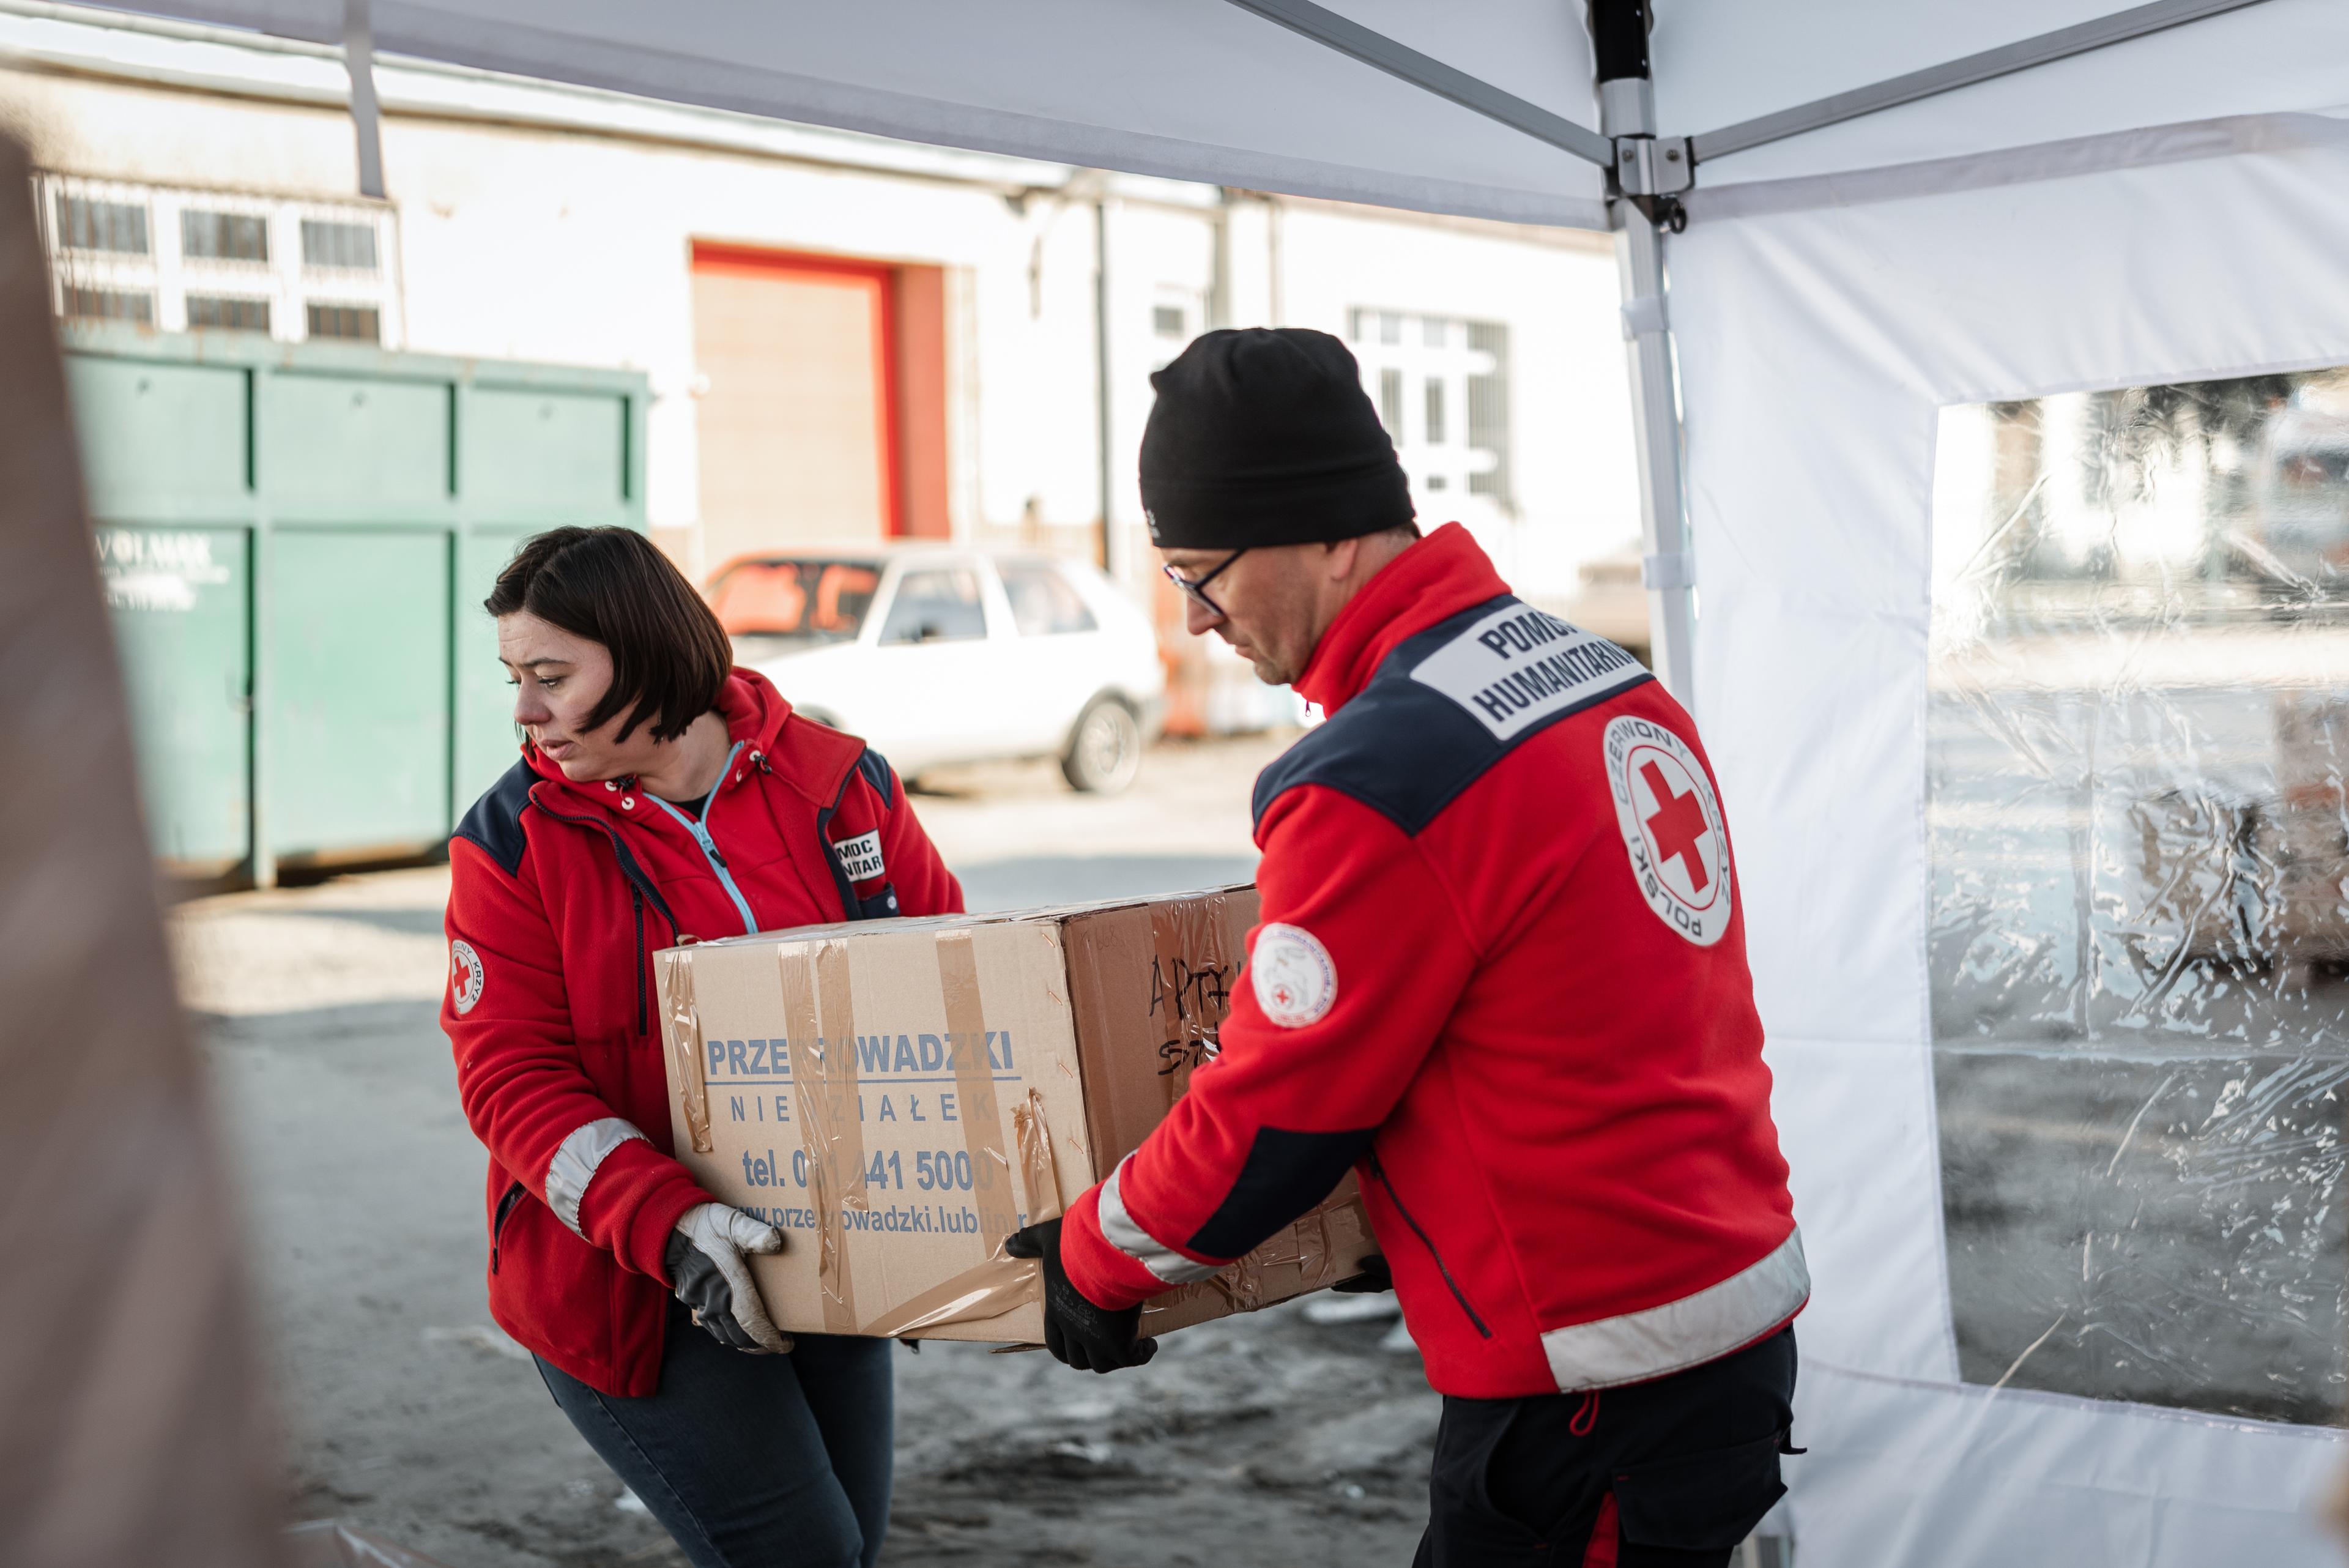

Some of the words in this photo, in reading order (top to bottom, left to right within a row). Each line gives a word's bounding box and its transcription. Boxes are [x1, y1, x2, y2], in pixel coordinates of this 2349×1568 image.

[1472, 640, 1635, 723] HUMANITARN
[836, 839, 873, 860] MOC
[843, 855, 881, 876] NITAR
[1630, 836, 1702, 937] POLSKI
[743, 1149, 785, 1187] tel.
